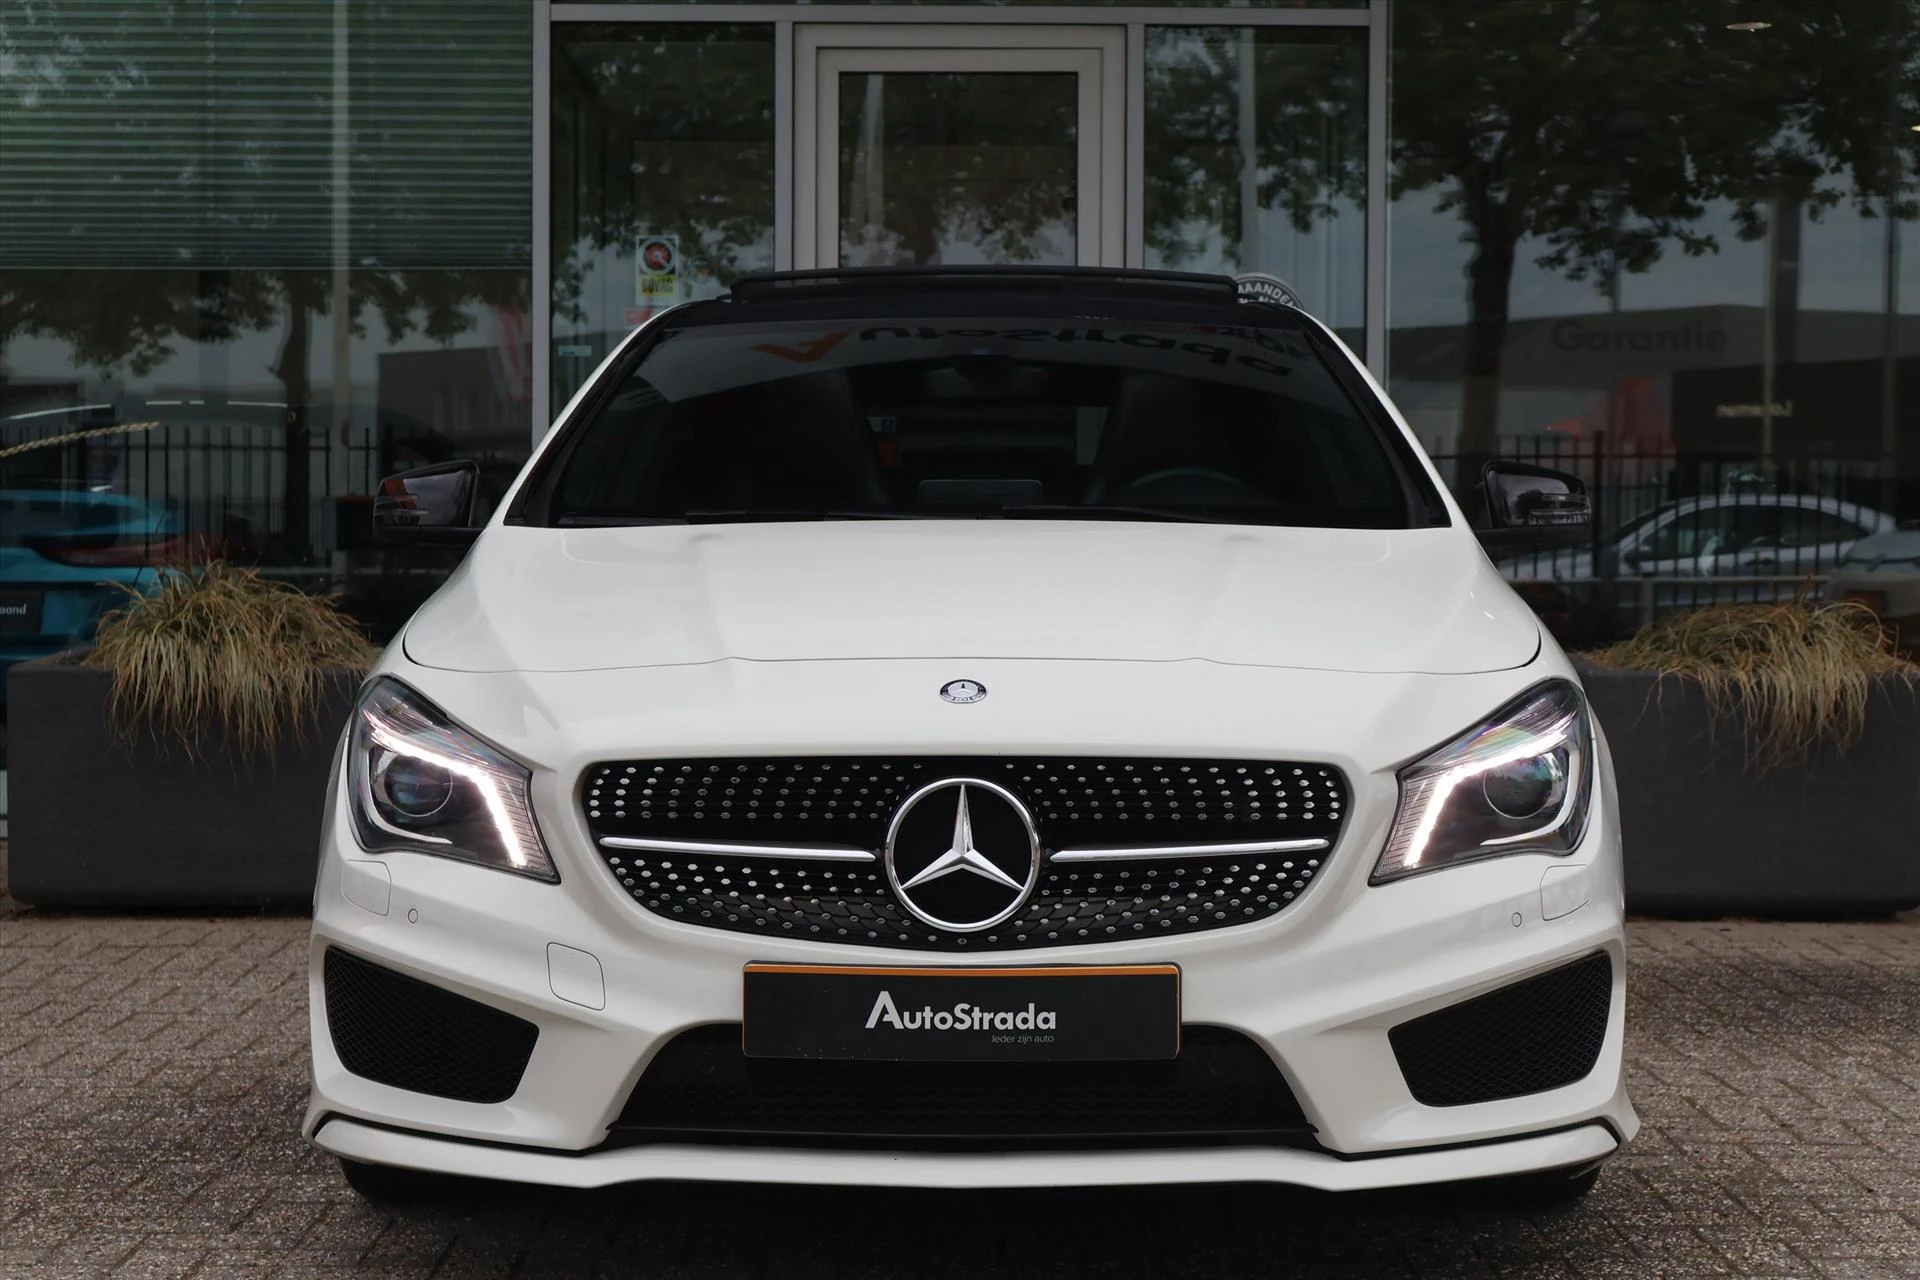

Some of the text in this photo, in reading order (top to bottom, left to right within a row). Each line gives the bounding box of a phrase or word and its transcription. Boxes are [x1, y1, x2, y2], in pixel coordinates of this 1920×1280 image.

[1552, 318, 1726, 352] Garantie
[865, 990, 1056, 1030] AutoStrada
[992, 1034, 1054, 1045] Ieder zijn auto
